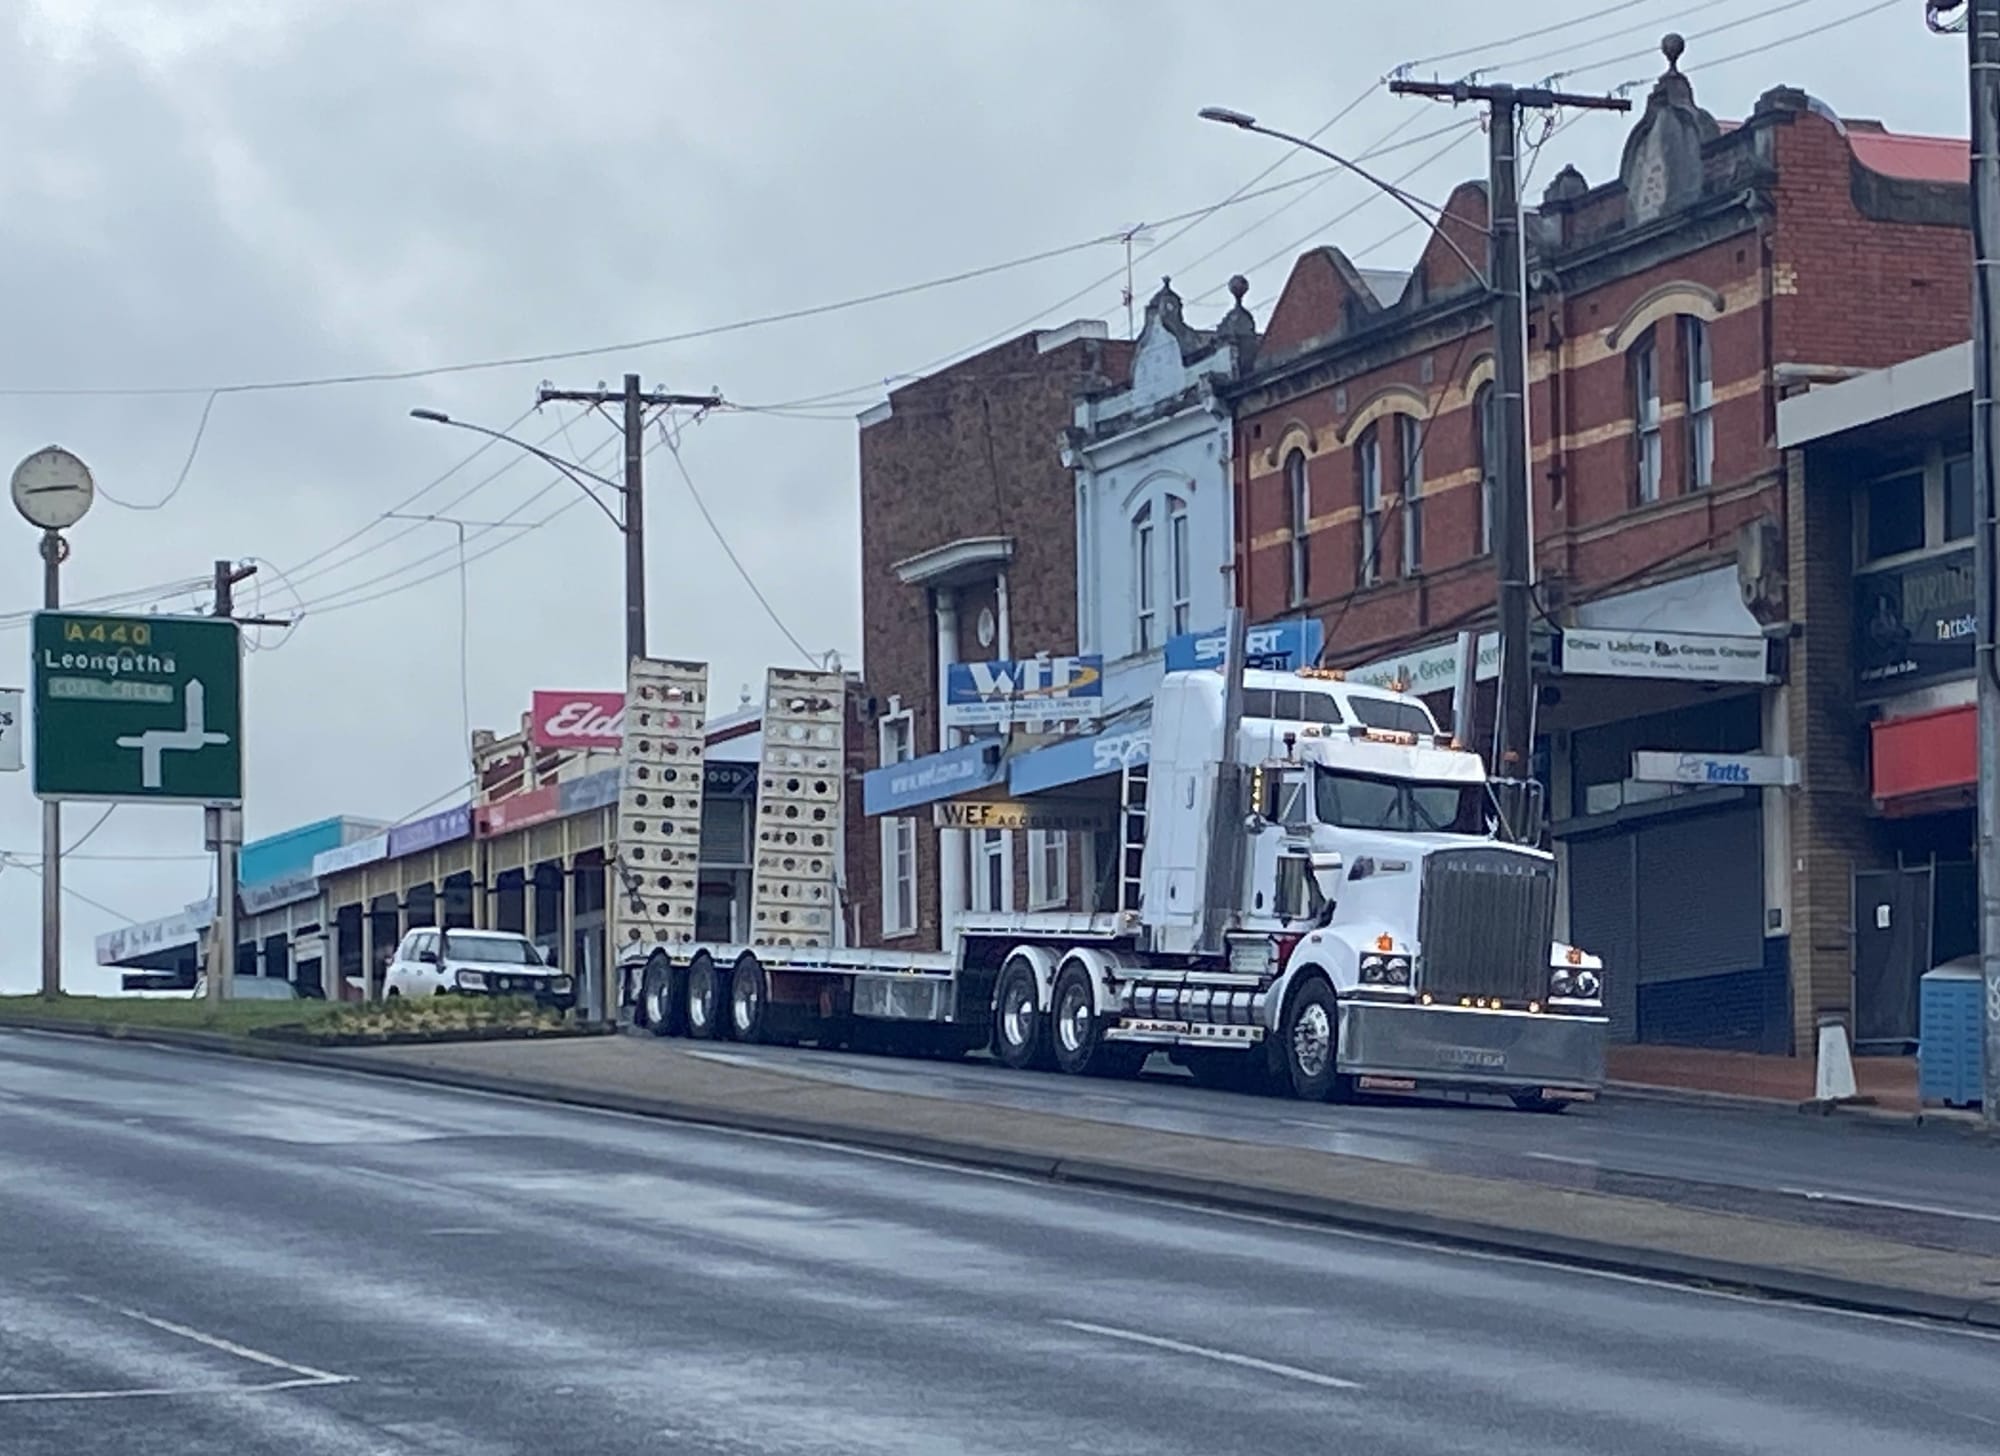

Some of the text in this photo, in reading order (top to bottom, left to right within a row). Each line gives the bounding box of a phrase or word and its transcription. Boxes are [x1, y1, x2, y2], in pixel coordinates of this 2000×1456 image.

[67, 622, 149, 646] A440
[1195, 629, 1284, 662] SPRT
[45, 649, 176, 676] Leongatha
[968, 657, 1082, 703] WEF
[544, 702, 624, 738] Eld
[1705, 761, 1750, 781] Tatts
[942, 804, 994, 827] WEF
